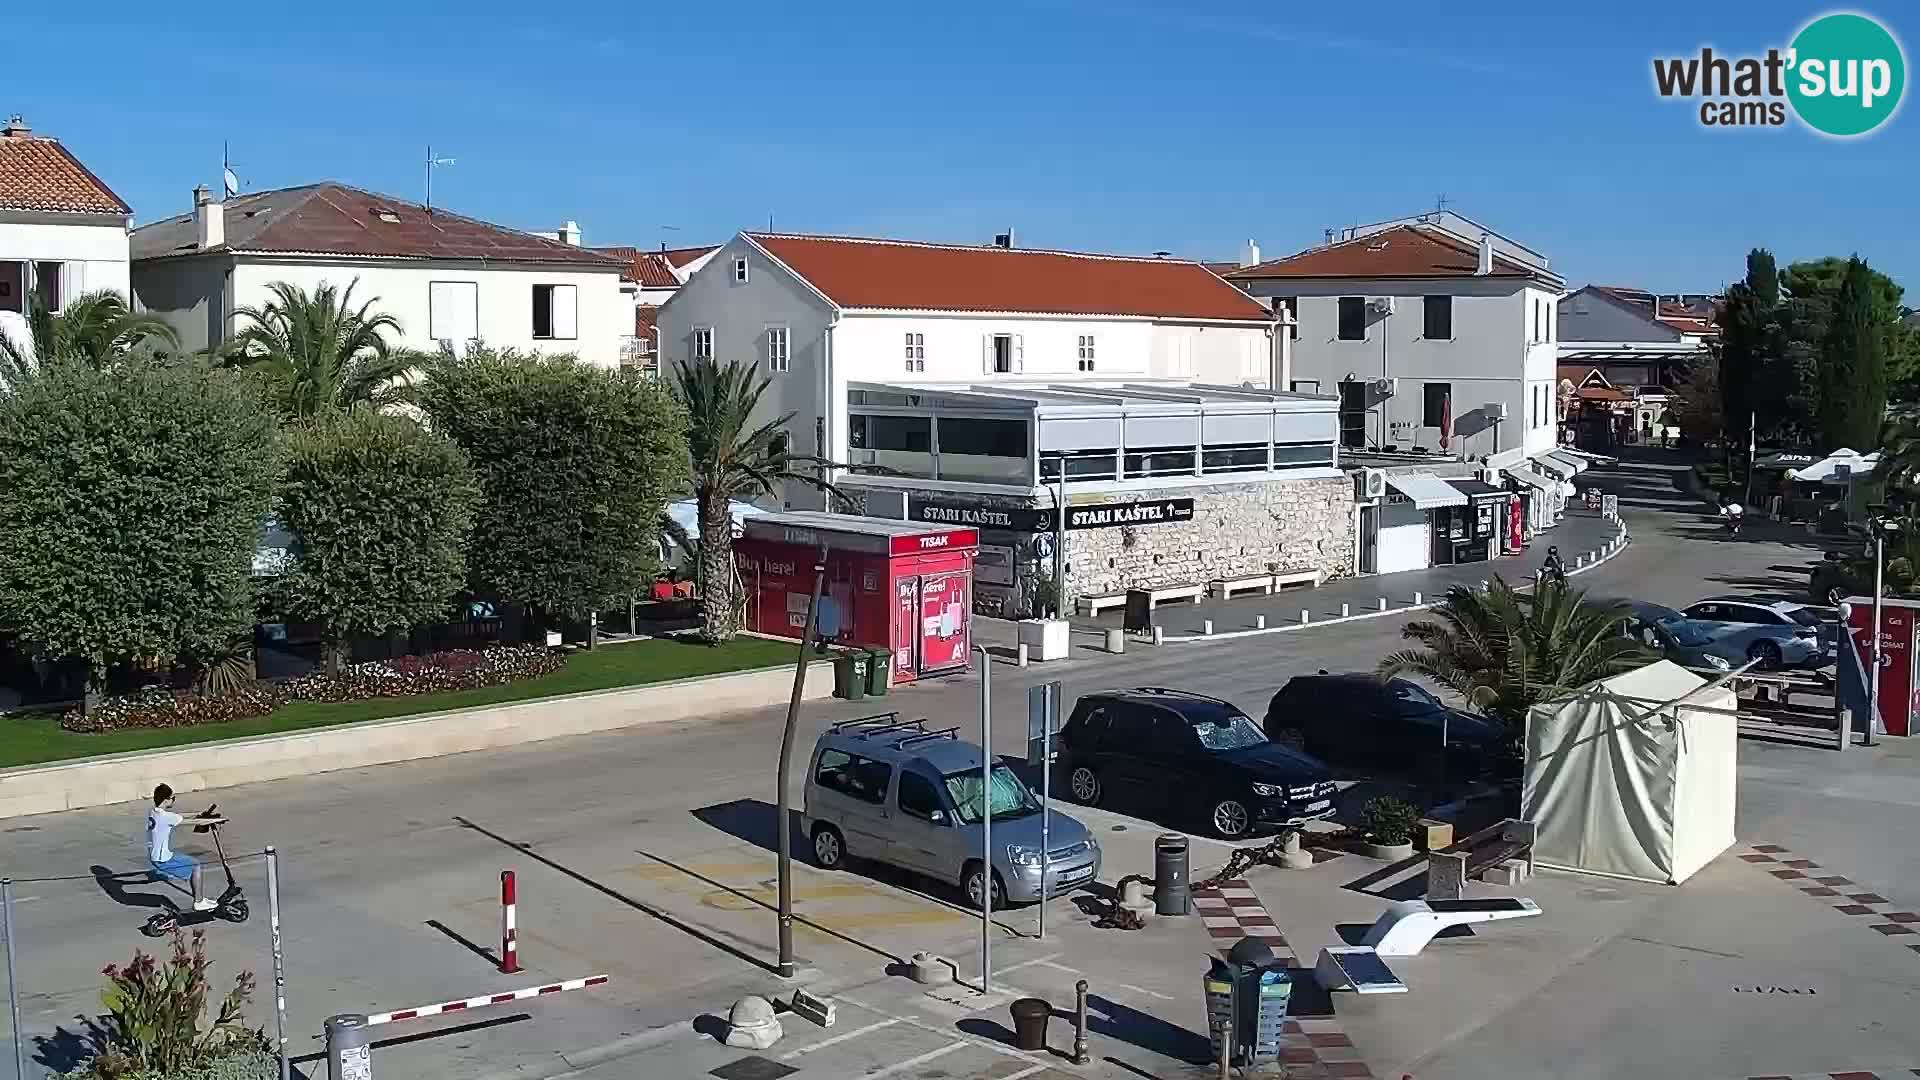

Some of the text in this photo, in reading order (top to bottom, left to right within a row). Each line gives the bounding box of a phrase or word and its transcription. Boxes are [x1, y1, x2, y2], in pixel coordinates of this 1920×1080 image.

[923, 506, 1012, 526] STARI KAŠTEL
[1072, 503, 1164, 526] STARI KAŠTEL
[919, 535, 949, 548] TISAK
